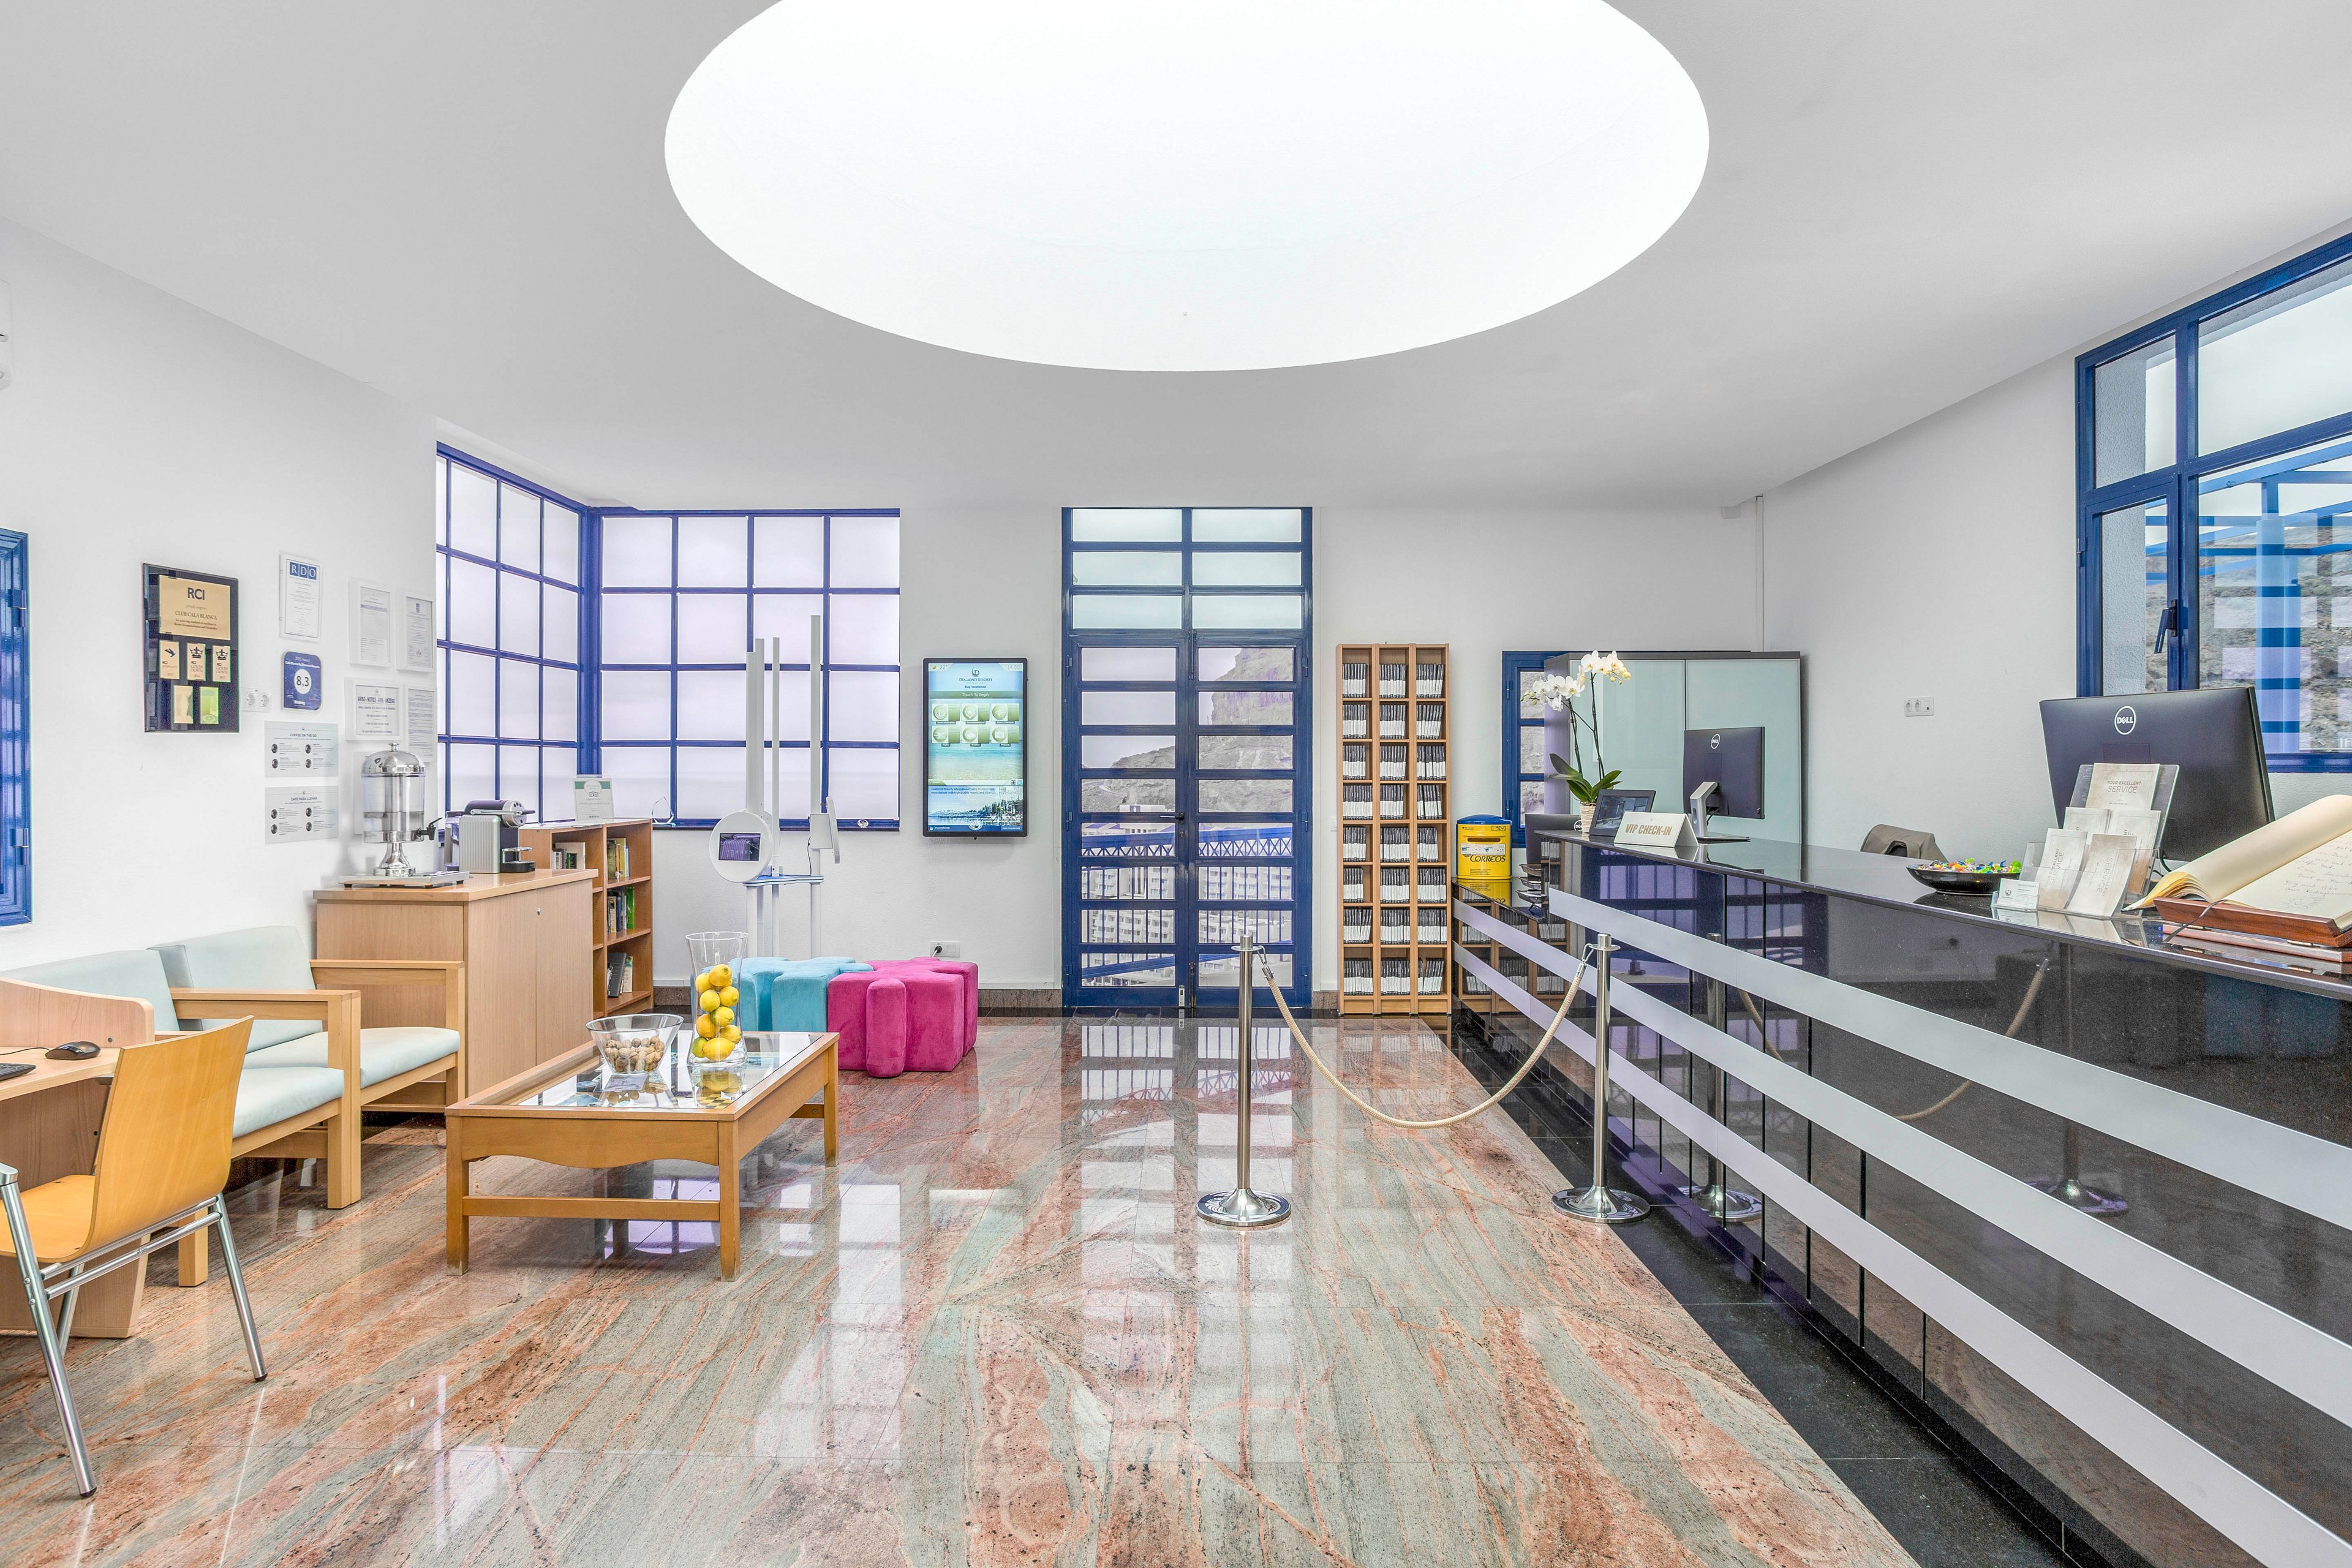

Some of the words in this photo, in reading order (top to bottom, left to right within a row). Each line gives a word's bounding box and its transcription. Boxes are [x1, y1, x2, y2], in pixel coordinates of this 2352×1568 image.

[291, 564, 316, 578] RDO
[187, 587, 205, 600] RCI
[296, 676, 309, 687] 8,3
[2117, 716, 2134, 725] DELL
[1625, 824, 1637, 833] VIP
[1638, 825, 1673, 835] CHECK-IN
[2049, 851, 2064, 886] SERVICE
[2097, 858, 2113, 893] SERVICE
